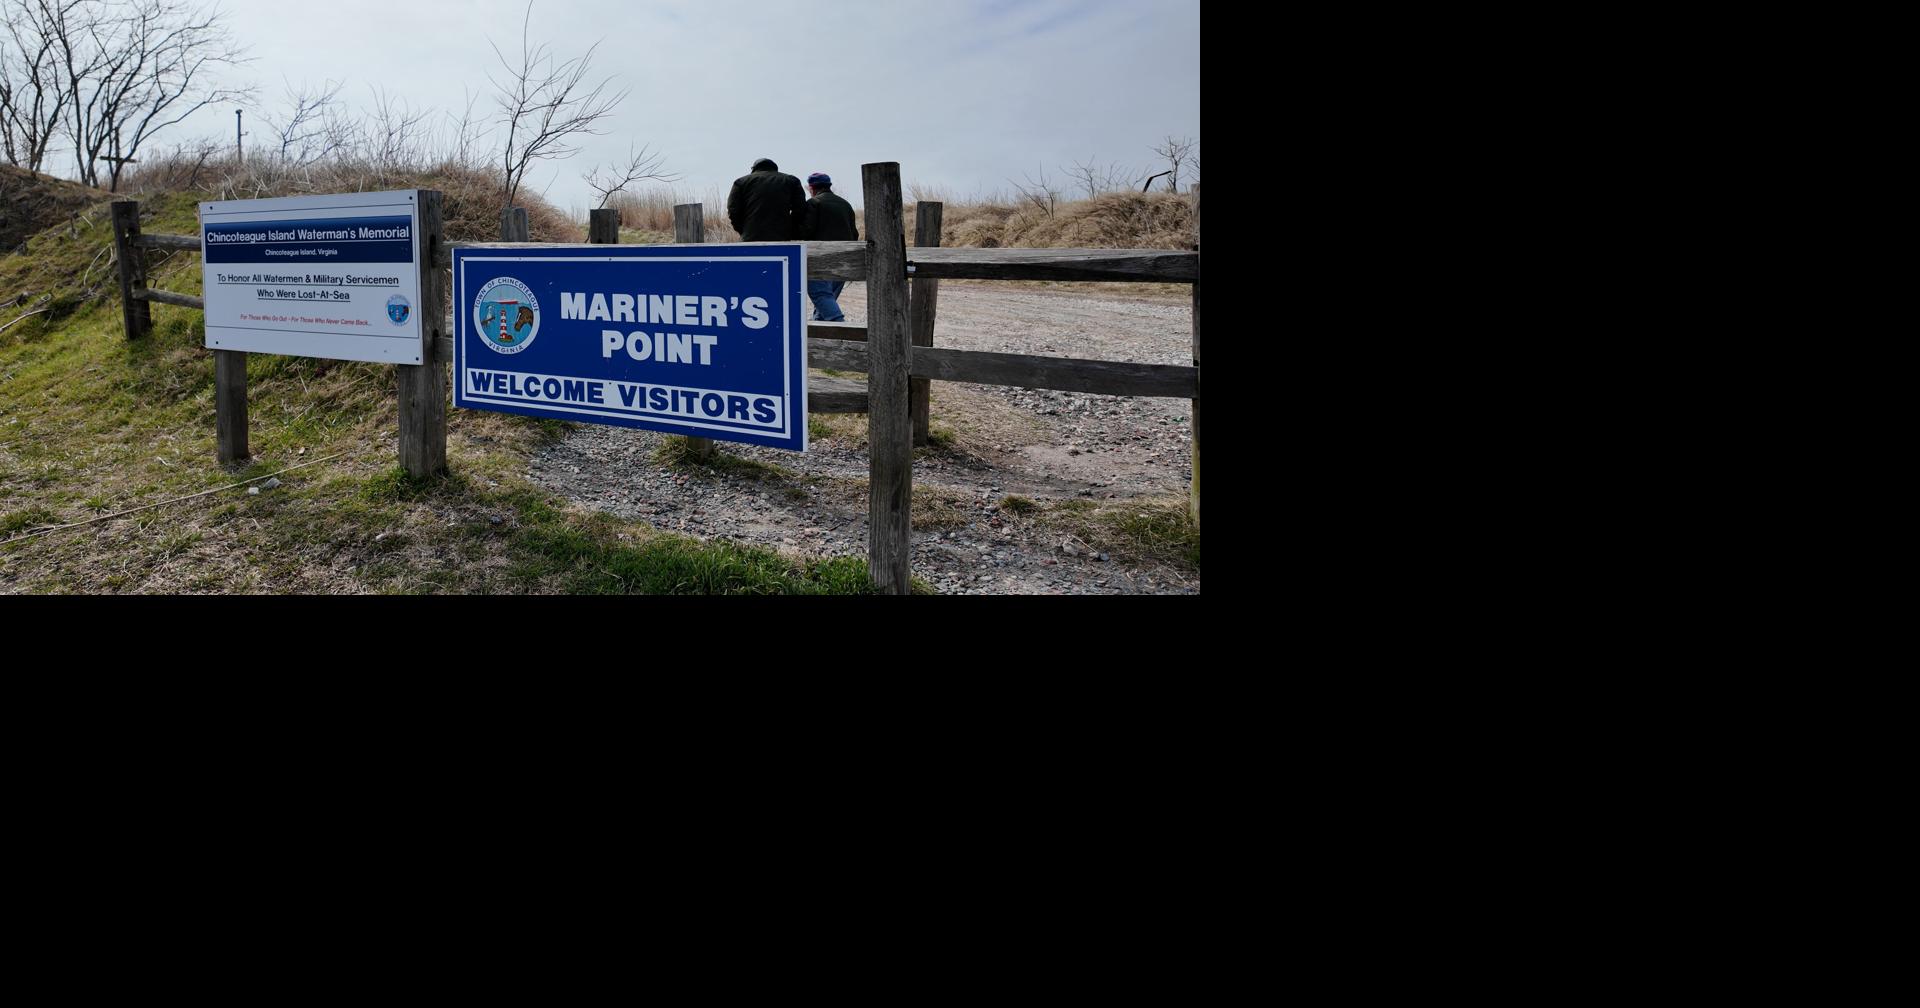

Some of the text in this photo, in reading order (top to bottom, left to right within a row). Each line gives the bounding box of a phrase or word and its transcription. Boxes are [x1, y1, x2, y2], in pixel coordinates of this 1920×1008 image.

[207, 226, 409, 243] Chincoteague Island Waterman's Memorial
[265, 249, 299, 257] Chincoteague
[318, 248, 338, 256] Virginia
[217, 273, 399, 286] To Honor All Watermen & Military Servicemen
[257, 289, 350, 300] Who Were Lost-At-Sea
[475, 289, 486, 308] TOWN
[498, 278, 539, 312] CHINCOTEAGUE
[560, 292, 769, 329] MARINER'S
[489, 341, 524, 353] VIRGINIA
[602, 330, 718, 365] POINT
[471, 371, 777, 424] WELCOME VISITORS
